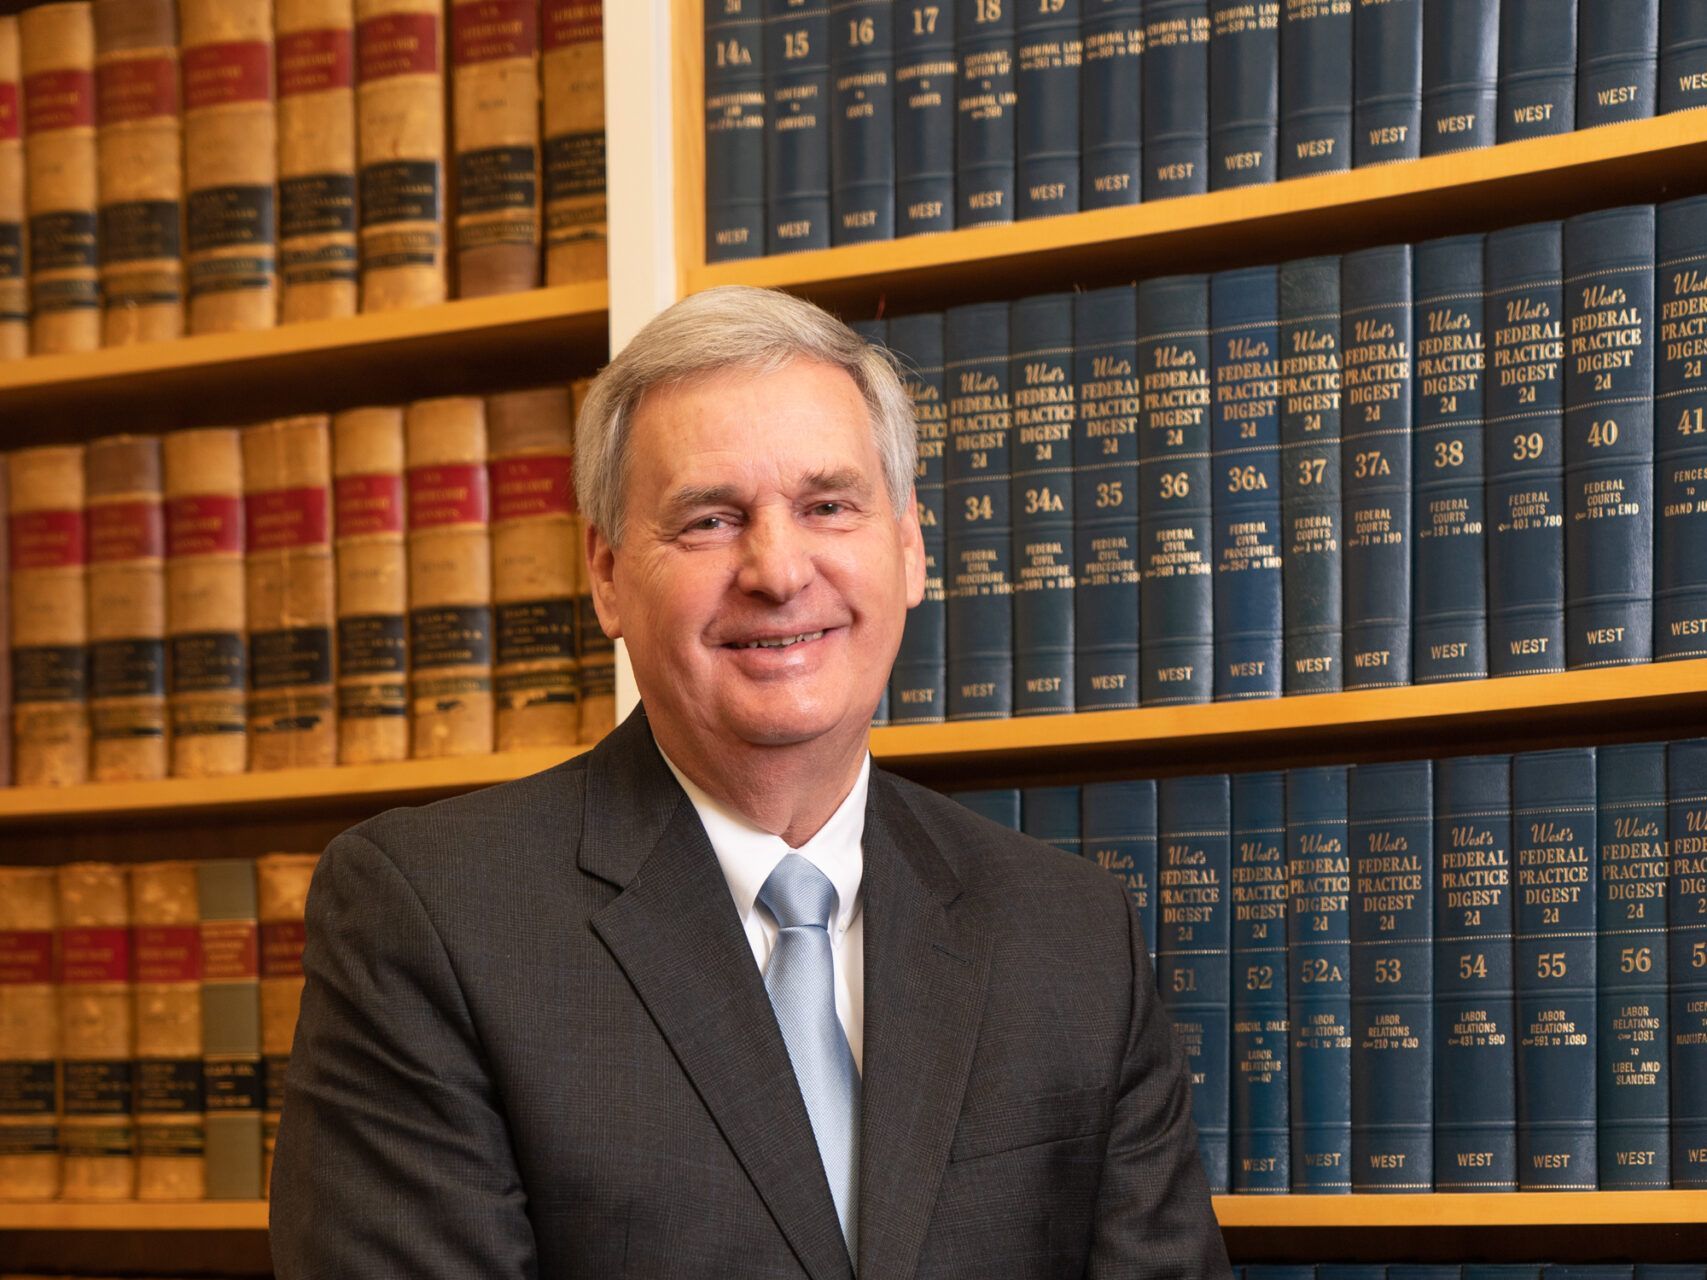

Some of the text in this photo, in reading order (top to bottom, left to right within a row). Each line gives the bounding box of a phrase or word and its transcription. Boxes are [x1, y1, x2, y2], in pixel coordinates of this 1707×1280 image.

[976, 0, 1002, 22] 18
[1259, 4, 1280, 15] LAW
[912, 9, 938, 34] 17
[849, 20, 874, 45] 16
[784, 33, 809, 58] 15
[1598, 86, 1637, 106] WEST
[1514, 105, 1553, 124] WEST
[1437, 116, 1475, 134] WEST
[1370, 127, 1408, 145] WEST
[1030, 184, 1065, 200] WEST
[969, 192, 1003, 210] WEST
[843, 210, 876, 227] WEST
[908, 201, 942, 219] WEST
[1582, 286, 1626, 308] West's
[1506, 300, 1549, 321] West's
[1572, 308, 1641, 333] FEDERAL
[1496, 323, 1565, 345] FEDERAL
[1572, 330, 1641, 355] PRACTICE
[1495, 343, 1565, 367] PRACTICE
[1577, 351, 1633, 373] DIGEST
[1501, 364, 1557, 385] DIGEST
[1595, 374, 1612, 390] 2d
[1678, 408, 1705, 435] 41
[1588, 420, 1618, 447] 40
[1435, 441, 1464, 467] 38
[1513, 433, 1543, 460] 39
[1299, 459, 1327, 485] 37
[1355, 452, 1390, 478] 37A
[1160, 473, 1189, 498] 36
[1228, 466, 1268, 491] 36A
[1097, 483, 1123, 507] 35
[1584, 480, 1625, 495] FEDERAL
[1025, 487, 1064, 514] 34A
[1430, 499, 1469, 514] FEDERAL
[1509, 491, 1550, 505] FEDERAL
[1587, 492, 1621, 505] COURTS
[965, 496, 992, 520] 34
[1355, 509, 1392, 522] FEDERAL
[1433, 510, 1466, 523] COURTS
[1512, 504, 1546, 517] COURTS
[1587, 504, 1639, 518] 781 END
[1356, 520, 1390, 534] COURTS
[1463, 522, 1482, 535] 400
[1513, 515, 1562, 529] 401 780
[1383, 532, 1402, 544] 190
[1587, 628, 1624, 644] WEST
[1431, 643, 1467, 659] WEST
[1511, 638, 1548, 654] WEST
[1158, 667, 1193, 682] WEST
[1531, 823, 1573, 843] West's
[1520, 847, 1588, 865] FEDERAL
[1519, 867, 1588, 884] PRACTICE
[1525, 887, 1580, 904] DIGEST
[1543, 909, 1559, 923] 2d
[1459, 954, 1487, 978] 54
[1537, 953, 1566, 978] 55
[1620, 948, 1651, 973] 56
[1247, 966, 1272, 990] 52
[1301, 959, 1342, 982] 52A
[1375, 959, 1401, 982] 53
[1173, 968, 1197, 992] 51
[1376, 1015, 1400, 1025] LABOR
[1461, 1011, 1486, 1022] LABOR
[1538, 1011, 1565, 1022] LABOR
[1621, 1006, 1649, 1017] LABOR
[1368, 1026, 1409, 1037] RELATIONS
[1454, 1022, 1496, 1034] RELATIONS
[1530, 1022, 1575, 1034] RELATIONS
[1613, 1017, 1659, 1029] RELATIONS
[1374, 1038, 1418, 1049] 210 430
[1460, 1035, 1505, 1046] 431 590
[1535, 1035, 1587, 1046] 591 1080
[1633, 1031, 1654, 1041] 1081
[1612, 1061, 1660, 1073] LIBEL AND
[1616, 1073, 1655, 1084] SLANDER
[1458, 1153, 1493, 1166] WEST
[1533, 1155, 1570, 1167] WEST
[1617, 1151, 1655, 1165] WEST
